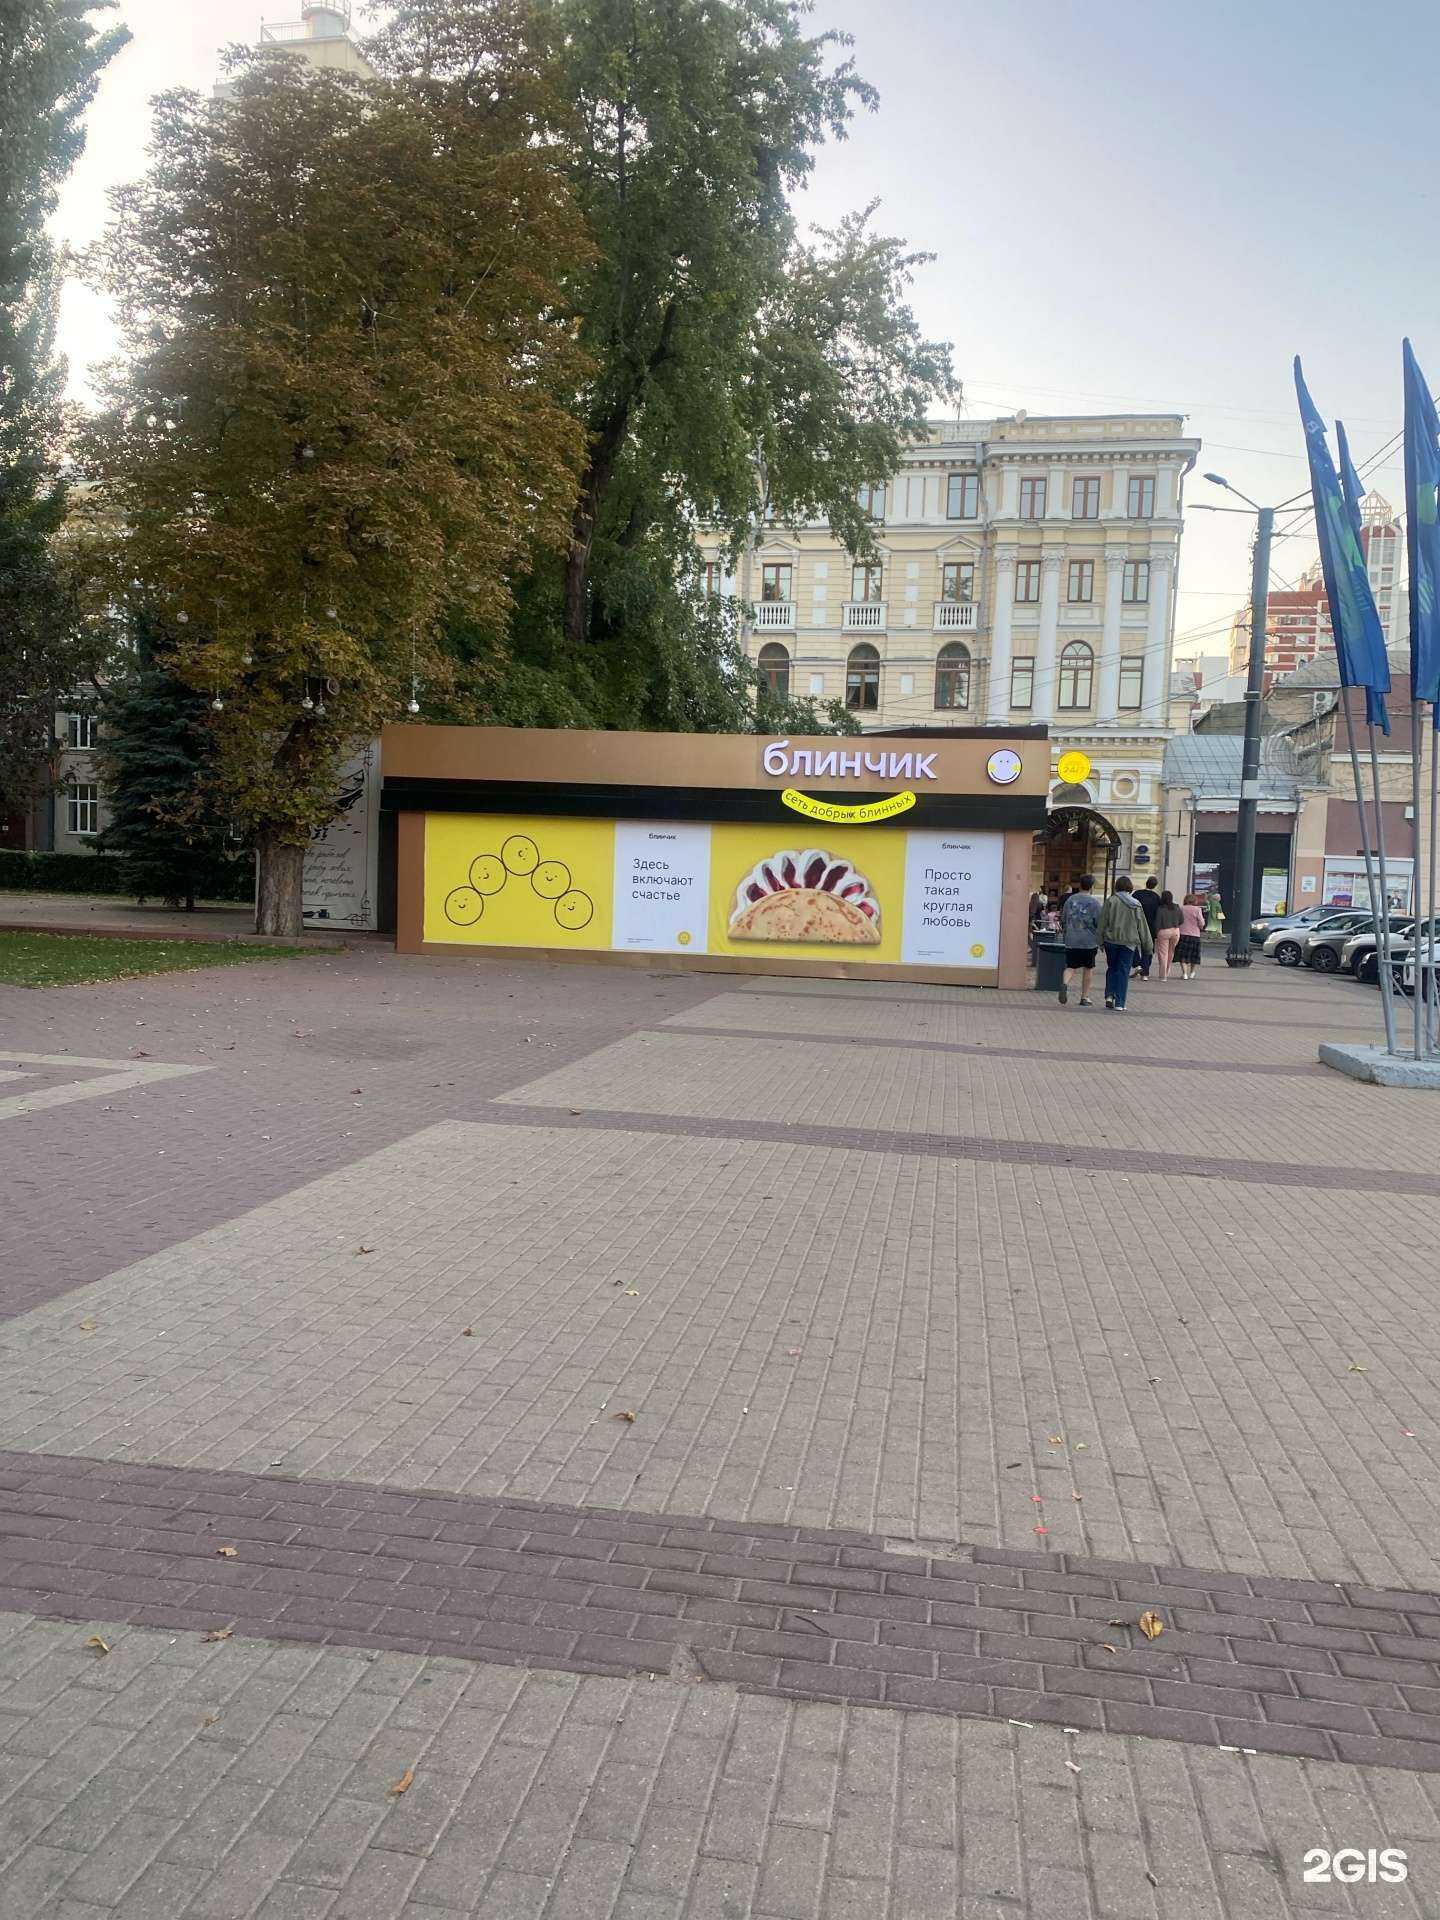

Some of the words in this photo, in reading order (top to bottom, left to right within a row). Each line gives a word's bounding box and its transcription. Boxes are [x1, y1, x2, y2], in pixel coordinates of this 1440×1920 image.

[763, 740, 938, 779] блинчик
[785, 792, 808, 810] сеть
[859, 794, 912, 818] блинных
[632, 858, 670, 871] Здесь
[632, 875, 694, 887] включают
[924, 868, 972, 882] Просто
[632, 889, 681, 901] счастье
[923, 885, 960, 896] такая
[923, 901, 973, 914] круглая
[921, 915, 971, 928] любовь
